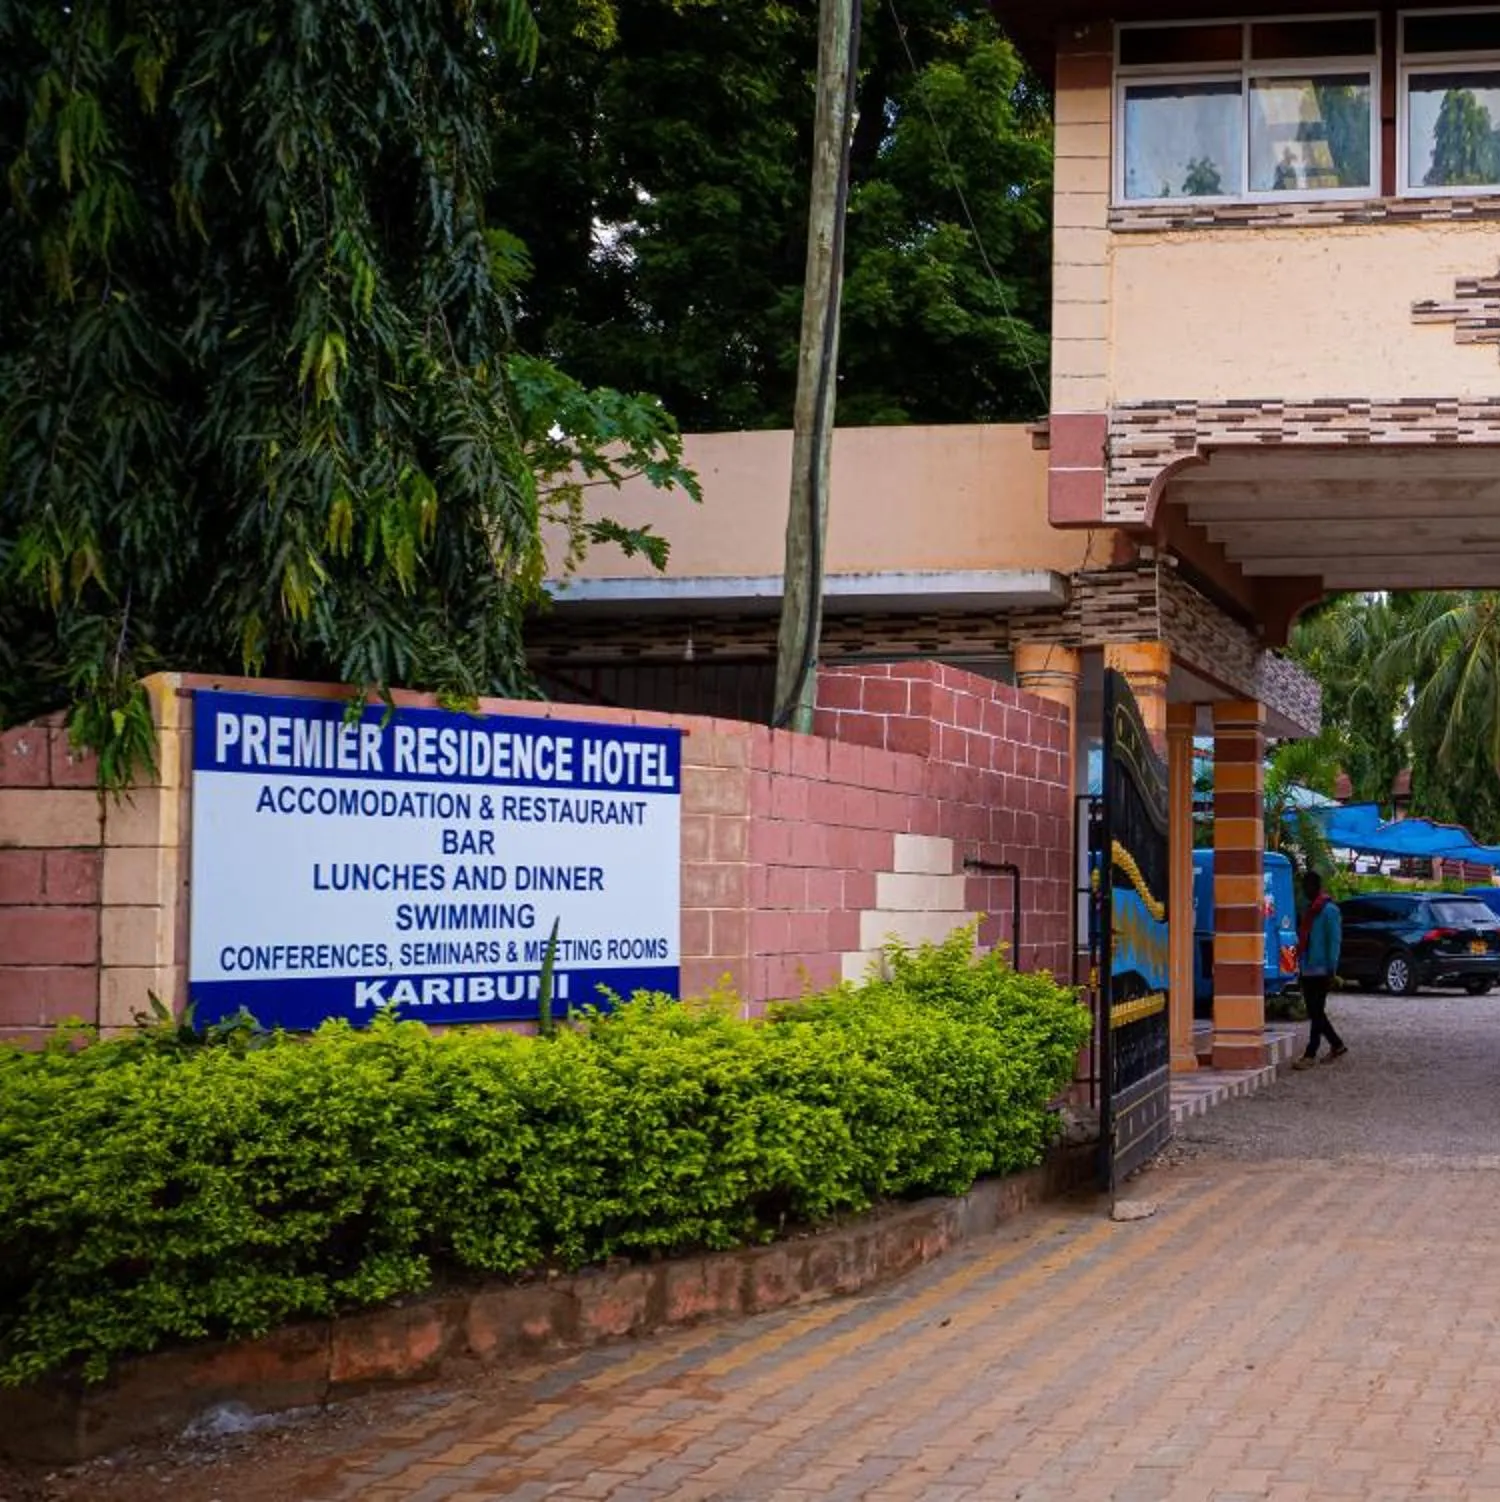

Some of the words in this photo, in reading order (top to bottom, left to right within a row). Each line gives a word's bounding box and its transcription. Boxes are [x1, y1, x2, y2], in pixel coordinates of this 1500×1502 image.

[215, 712, 383, 772] PREMIER
[393, 725, 573, 782] RESIDENCE
[581, 738, 674, 787] HOTEL
[256, 786, 471, 820] ACCOMODATION
[479, 795, 494, 820] &
[502, 796, 647, 825] RESTAURANT
[442, 829, 495, 855] BAR
[313, 864, 445, 890] LUNCHES
[452, 866, 506, 891] AND
[515, 866, 604, 891] DINNER
[395, 903, 535, 931] SWIMMING
[219, 943, 394, 971] CONFERENCES,
[399, 940, 500, 967] SEMINARS
[507, 940, 518, 963] &
[524, 939, 602, 963] MEETING
[607, 937, 669, 961] ROOMS
